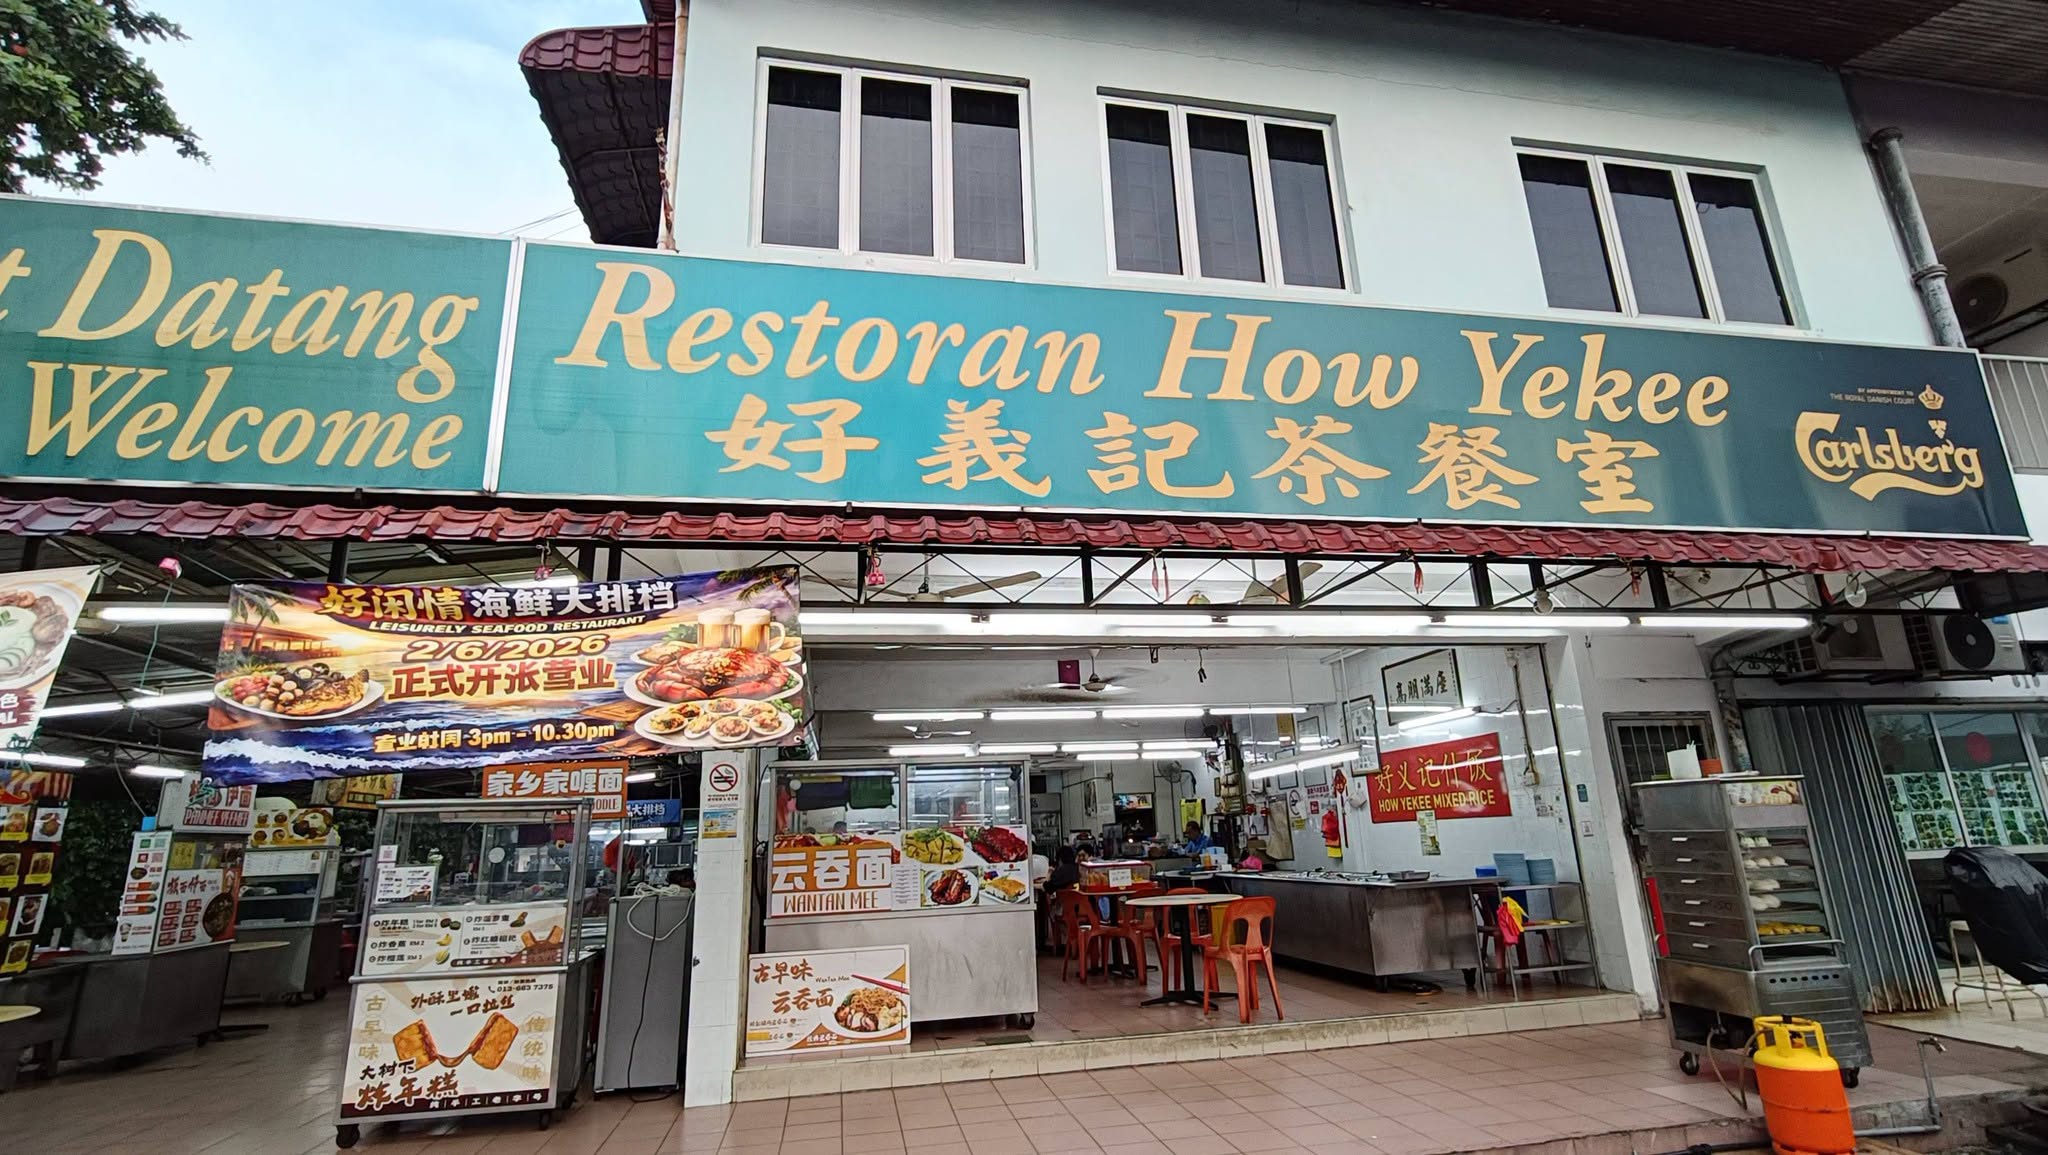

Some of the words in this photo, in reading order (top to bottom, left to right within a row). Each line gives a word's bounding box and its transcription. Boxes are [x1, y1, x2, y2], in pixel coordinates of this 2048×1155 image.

[37, 229, 480, 404] Datang
[554, 261, 1105, 395] Restoran
[1144, 308, 1419, 411] How
[1459, 329, 1730, 427] Yekee
[26, 361, 464, 470] Welcome
[704, 393, 1660, 514] 好義記茶餐室
[1795, 411, 1984, 501] Carlsberg
[315, 585, 465, 621] 好闲情
[470, 581, 675, 618] 海鲜大排档
[369, 621, 468, 634] LEISURELY
[471, 623, 548, 634] SEAFOOD
[552, 615, 646, 632] RESTAURANT
[403, 634, 610, 663] 2/6/2026
[388, 657, 615, 700] 正式开张营业
[468, 728, 511, 748] 3pm
[532, 722, 615, 742] 10.30pm
[1379, 797, 1399, 812] HOW
[1400, 795, 1432, 811] YEKEE
[773, 849, 891, 890] 云吞面
[783, 892, 845, 913] WANTAN
[850, 890, 879, 909] MEE
[753, 958, 814, 985] 古早味
[772, 987, 834, 1015] 云吞面
[358, 994, 386, 1061] 古早味
